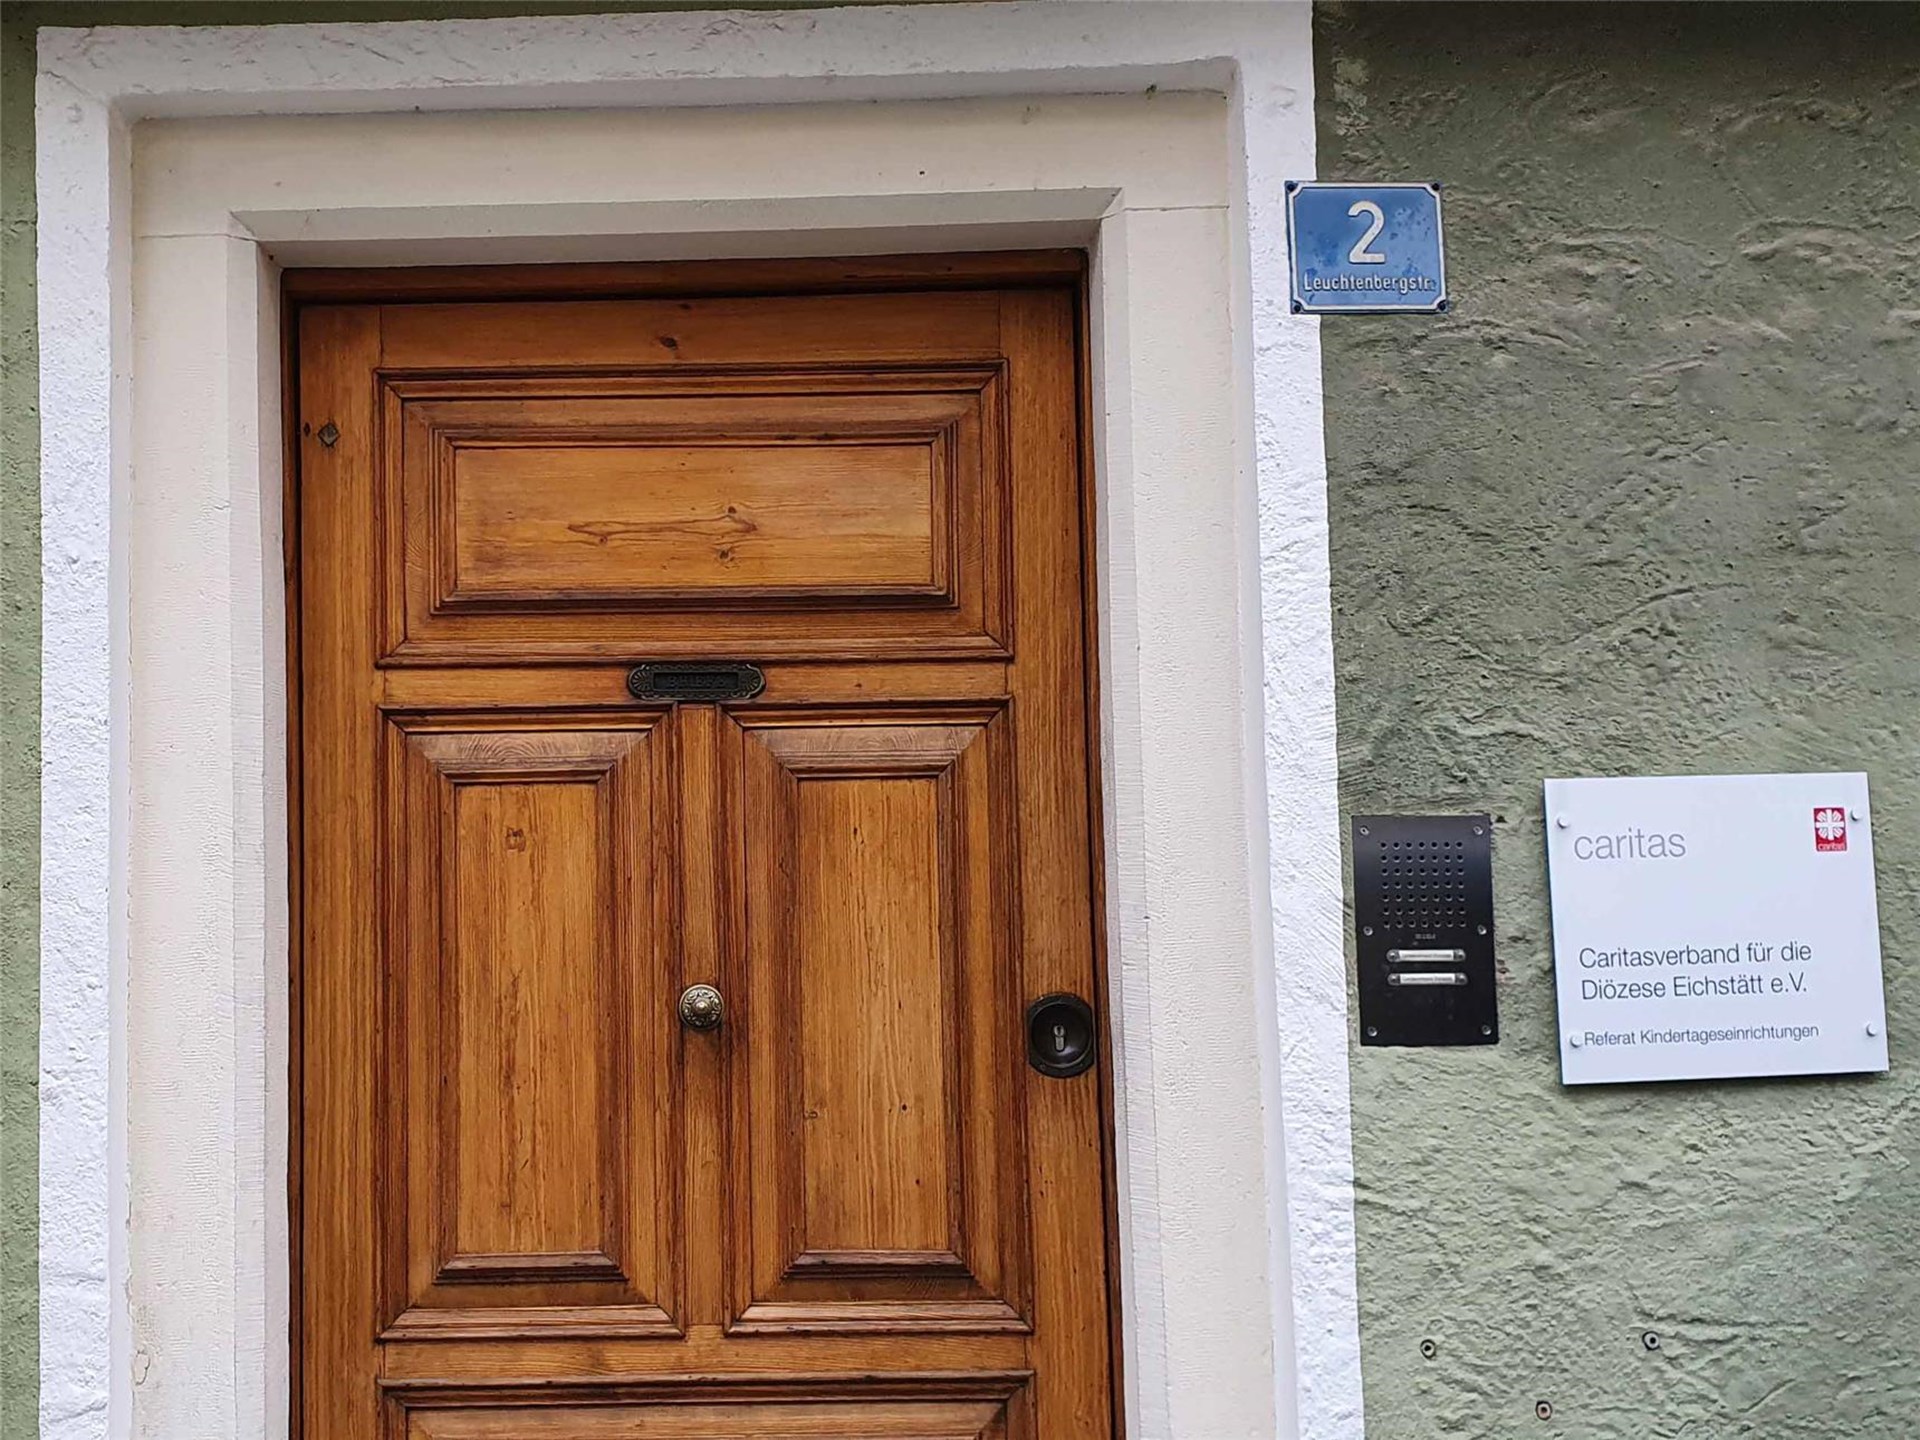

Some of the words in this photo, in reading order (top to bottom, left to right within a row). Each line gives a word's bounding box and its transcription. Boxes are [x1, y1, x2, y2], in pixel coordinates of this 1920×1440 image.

[1348, 201, 1386, 263] 2
[1574, 828, 1686, 860] caritas
[1579, 944, 1740, 968] Caritasverband
[1747, 942, 1774, 962] für
[1780, 940, 1812, 961] die
[1581, 977, 1666, 1000] Diözese
[1673, 974, 1764, 997] Eichstätt
[1770, 972, 1807, 993] e.V.
[1584, 1031, 1636, 1047] Referat
[1640, 1025, 1820, 1044] Kindertageseinrichtungen
